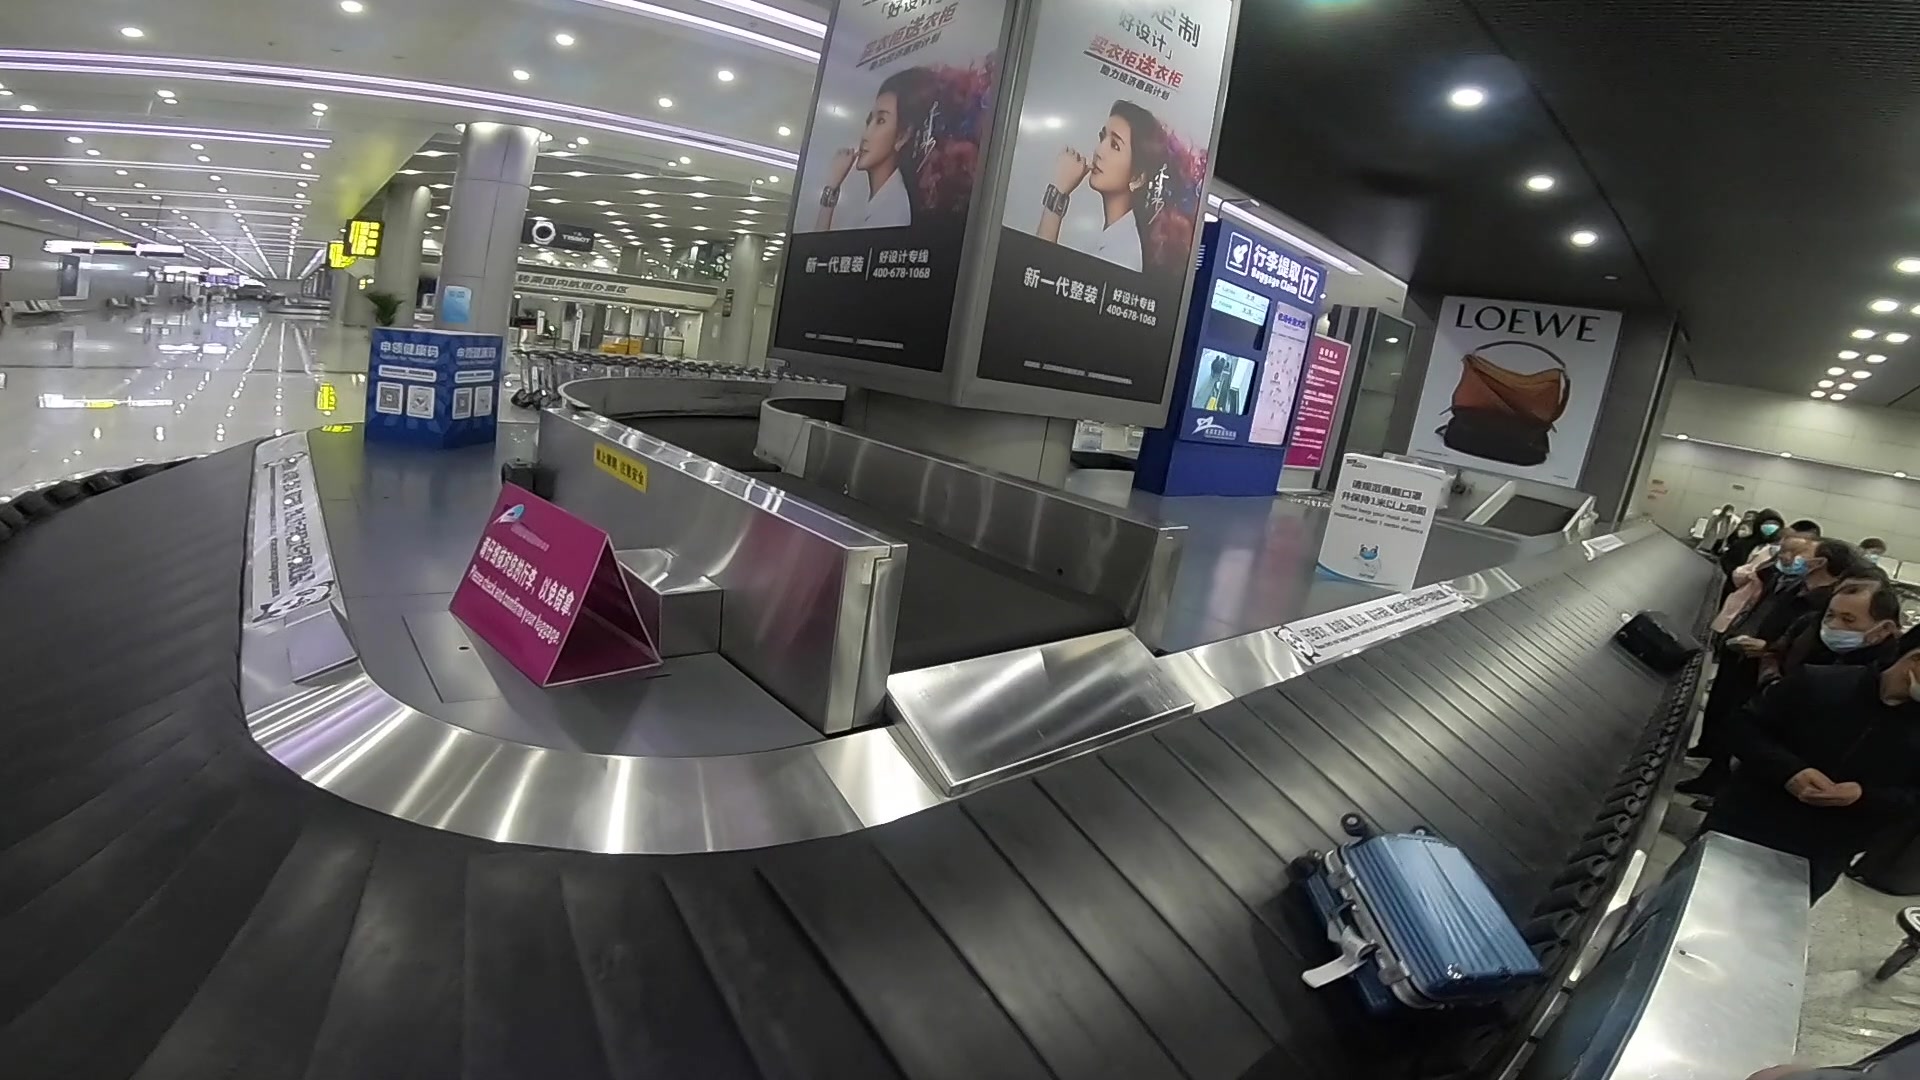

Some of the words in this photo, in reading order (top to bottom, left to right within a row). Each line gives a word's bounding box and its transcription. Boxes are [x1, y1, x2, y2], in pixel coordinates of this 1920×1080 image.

[1089, 34, 1184, 88] 买衣柜送衣柜
[562, 233, 591, 243] TISSOT
[805, 256, 864, 273] 新一代整装
[878, 249, 929, 263] 好设计专线
[1253, 243, 1302, 283] 行李提取
[872, 267, 930, 279] 400-678-1068
[1023, 266, 1099, 305] 新一代整装
[1251, 266, 1280, 288] Baggage
[1280, 279, 1298, 295] Claim
[1302, 272, 1318, 298] 17
[1112, 287, 1156, 312] 好设计专线
[1106, 304, 1157, 326] 400-678-1068
[1455, 303, 1601, 343] LOEWE
[468, 564, 485, 586] Please
[520, 608, 537, 625] your
